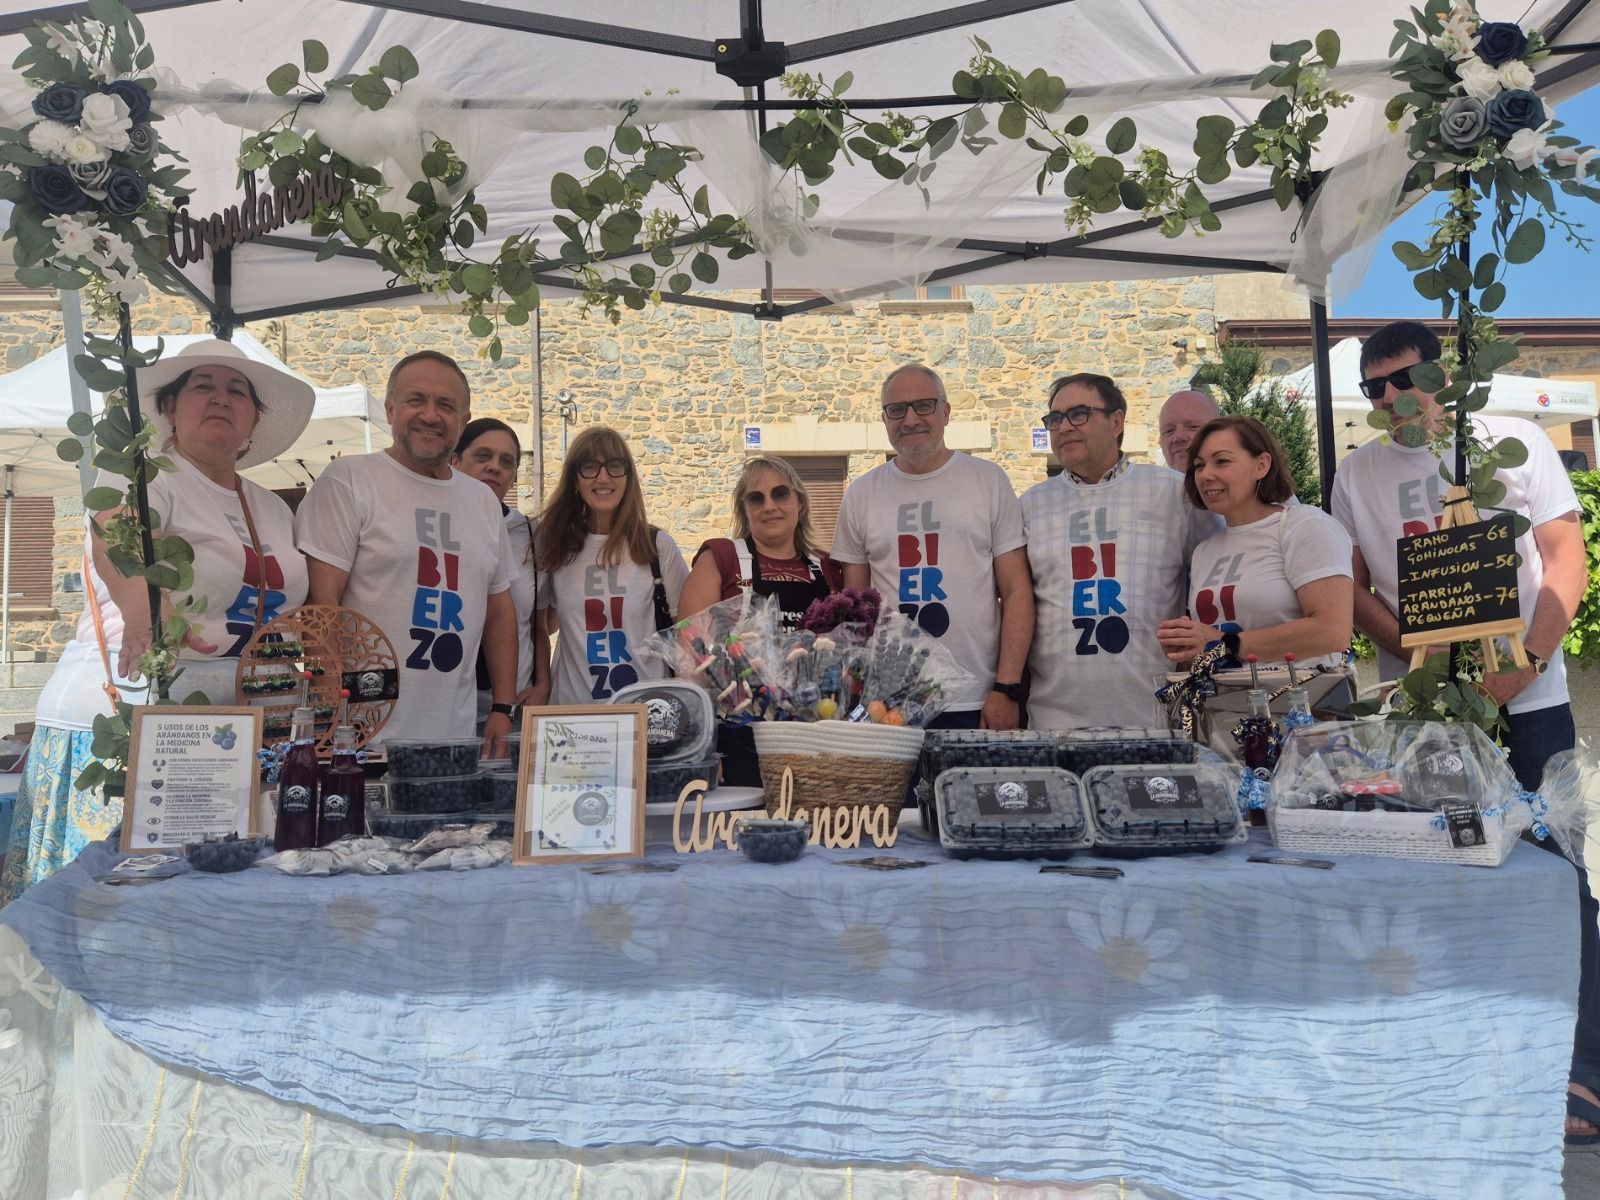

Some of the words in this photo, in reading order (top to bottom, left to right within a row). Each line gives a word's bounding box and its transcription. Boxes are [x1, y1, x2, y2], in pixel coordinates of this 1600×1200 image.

[415, 508, 461, 551] EL
[897, 501, 941, 532] EL
[1069, 507, 1117, 543] EL
[898, 533, 938, 567] BI
[1071, 543, 1116, 580] BI
[417, 546, 459, 591] BI
[584, 565, 627, 596] EL
[899, 567, 947, 602] ER
[1202, 552, 1245, 587] EL
[411, 587, 465, 632] ER
[584, 596, 624, 632] BI
[1073, 579, 1127, 616] ER
[1196, 585, 1236, 625] BI
[405, 628, 464, 673] ZO
[587, 630, 632, 664] ER
[1072, 616, 1130, 656] ZO
[589, 664, 638, 699] ZO
[157, 723, 163, 731] 5
[155, 747, 188, 755] NATURAL
[672, 766, 898, 853] Aradnera
